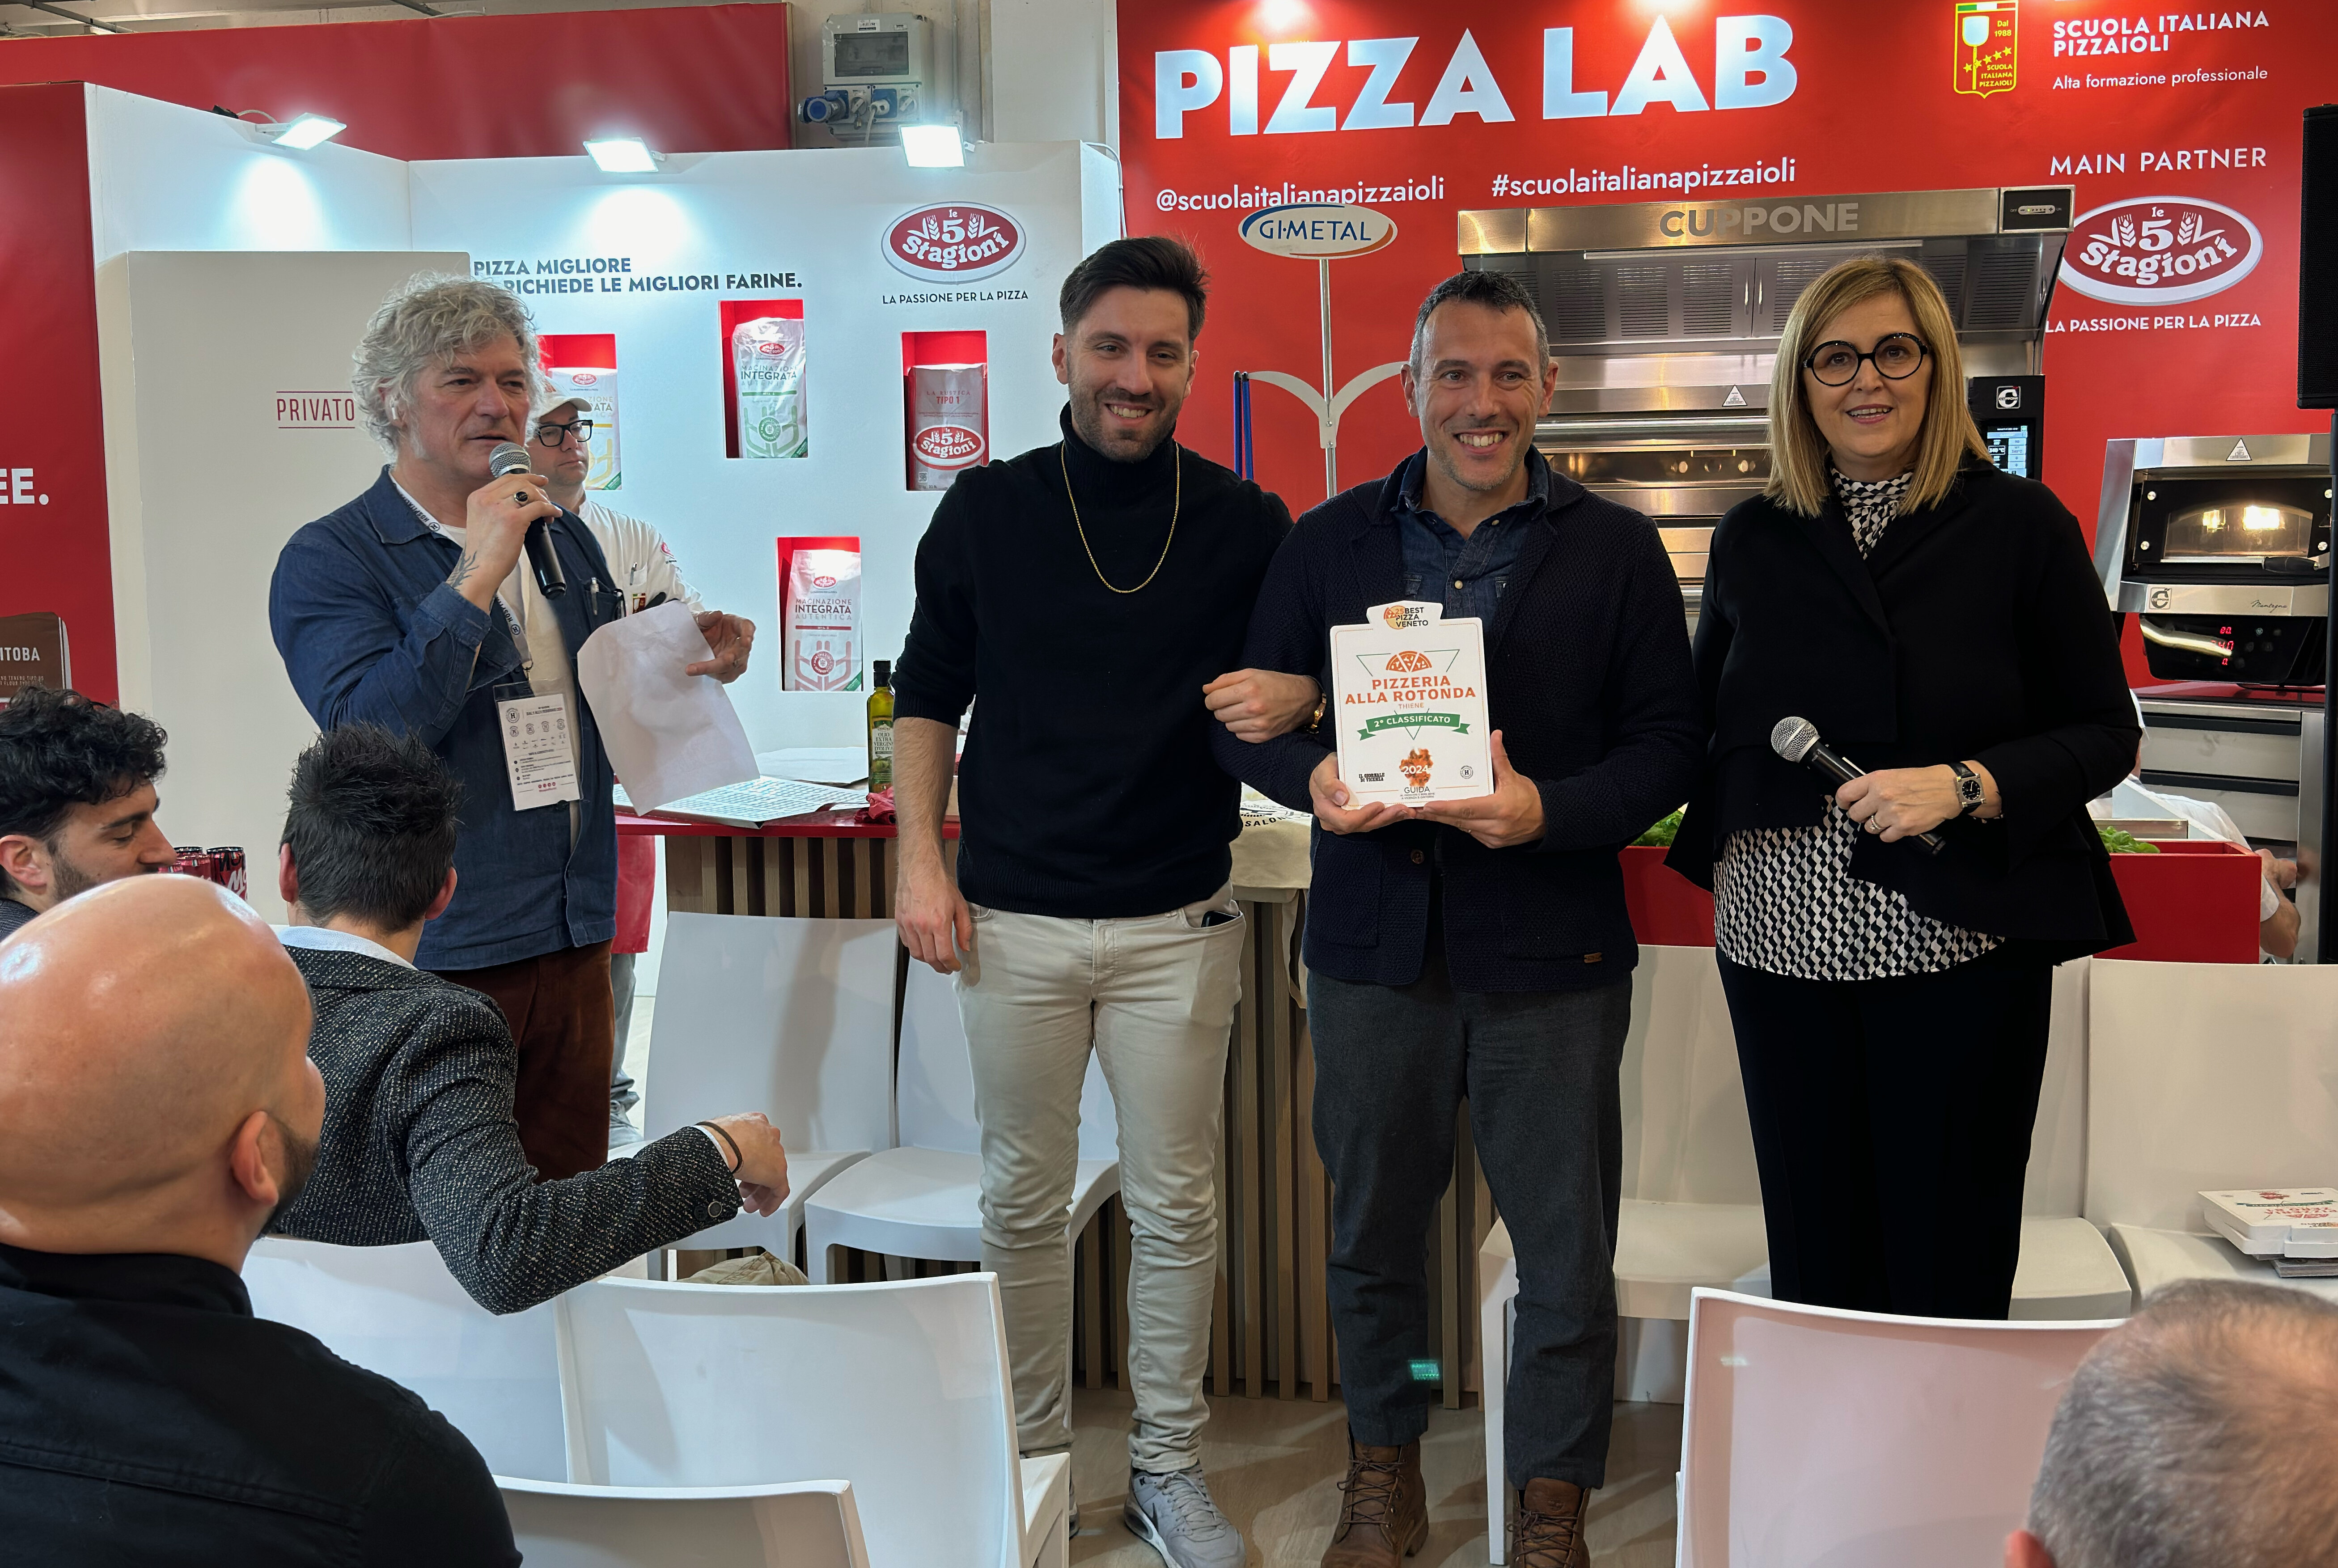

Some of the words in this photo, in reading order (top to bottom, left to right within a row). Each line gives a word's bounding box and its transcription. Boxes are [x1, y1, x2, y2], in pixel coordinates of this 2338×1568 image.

[2054, 17, 2150, 39] SCUOLA
[2159, 11, 2270, 34] ITALIANA
[2054, 34, 2169, 57] PIZZAIOLI
[1155, 28, 1515, 139] PIZZA
[1543, 14, 1797, 120] LAB
[2053, 76, 2080, 90] Alta
[2086, 73, 2166, 88] formazione
[2172, 66, 2268, 85] professionale
[2050, 153, 2125, 176] MAIN
[2141, 148, 2267, 171] PARTNER
[1492, 157, 1795, 197] #scuolaitalianapizzaioli
[1156, 177, 1444, 211] @scuolaitalianapizzaioli
[949, 209, 957, 218] le
[1660, 203, 1859, 238] CUPPONE
[2152, 207, 2164, 218] le
[942, 218, 965, 243] 5
[2139, 218, 2173, 251] 5
[902, 231, 1009, 269] Stagioni
[2080, 236, 2237, 285] Stagioni
[474, 259, 530, 275] PIZZA
[537, 258, 631, 274] MIGLIORE
[601, 277, 621, 293] LE
[628, 275, 719, 292] MIGLIORI
[726, 272, 803, 290] FARINE.
[883, 295, 896, 304] LA
[900, 293, 953, 304] PASSIONE
[957, 292, 976, 302] PER
[980, 291, 993, 301] LA
[997, 290, 1028, 300] PIZZA
[2045, 320, 2066, 333] LA
[2071, 317, 2149, 332] PASSIONE
[2155, 316, 2184, 329] PER
[2190, 315, 2210, 328] LA
[2215, 313, 2261, 327] PIZZA
[741, 371, 796, 380] INTEGRATA
[277, 398, 355, 421] PRIVATO
[921, 440, 976, 458] Stagioni
[940, 433, 953, 445] 5
[795, 605, 851, 614] INTEGRATA
[1372, 676, 1450, 690] PIZZERIA
[1345, 692, 1388, 704] ALLA
[1393, 687, 1476, 702] ROTONDA
[1387, 716, 1450, 725] CLASSIFICATO
[1403, 765, 1430, 775] 2024
